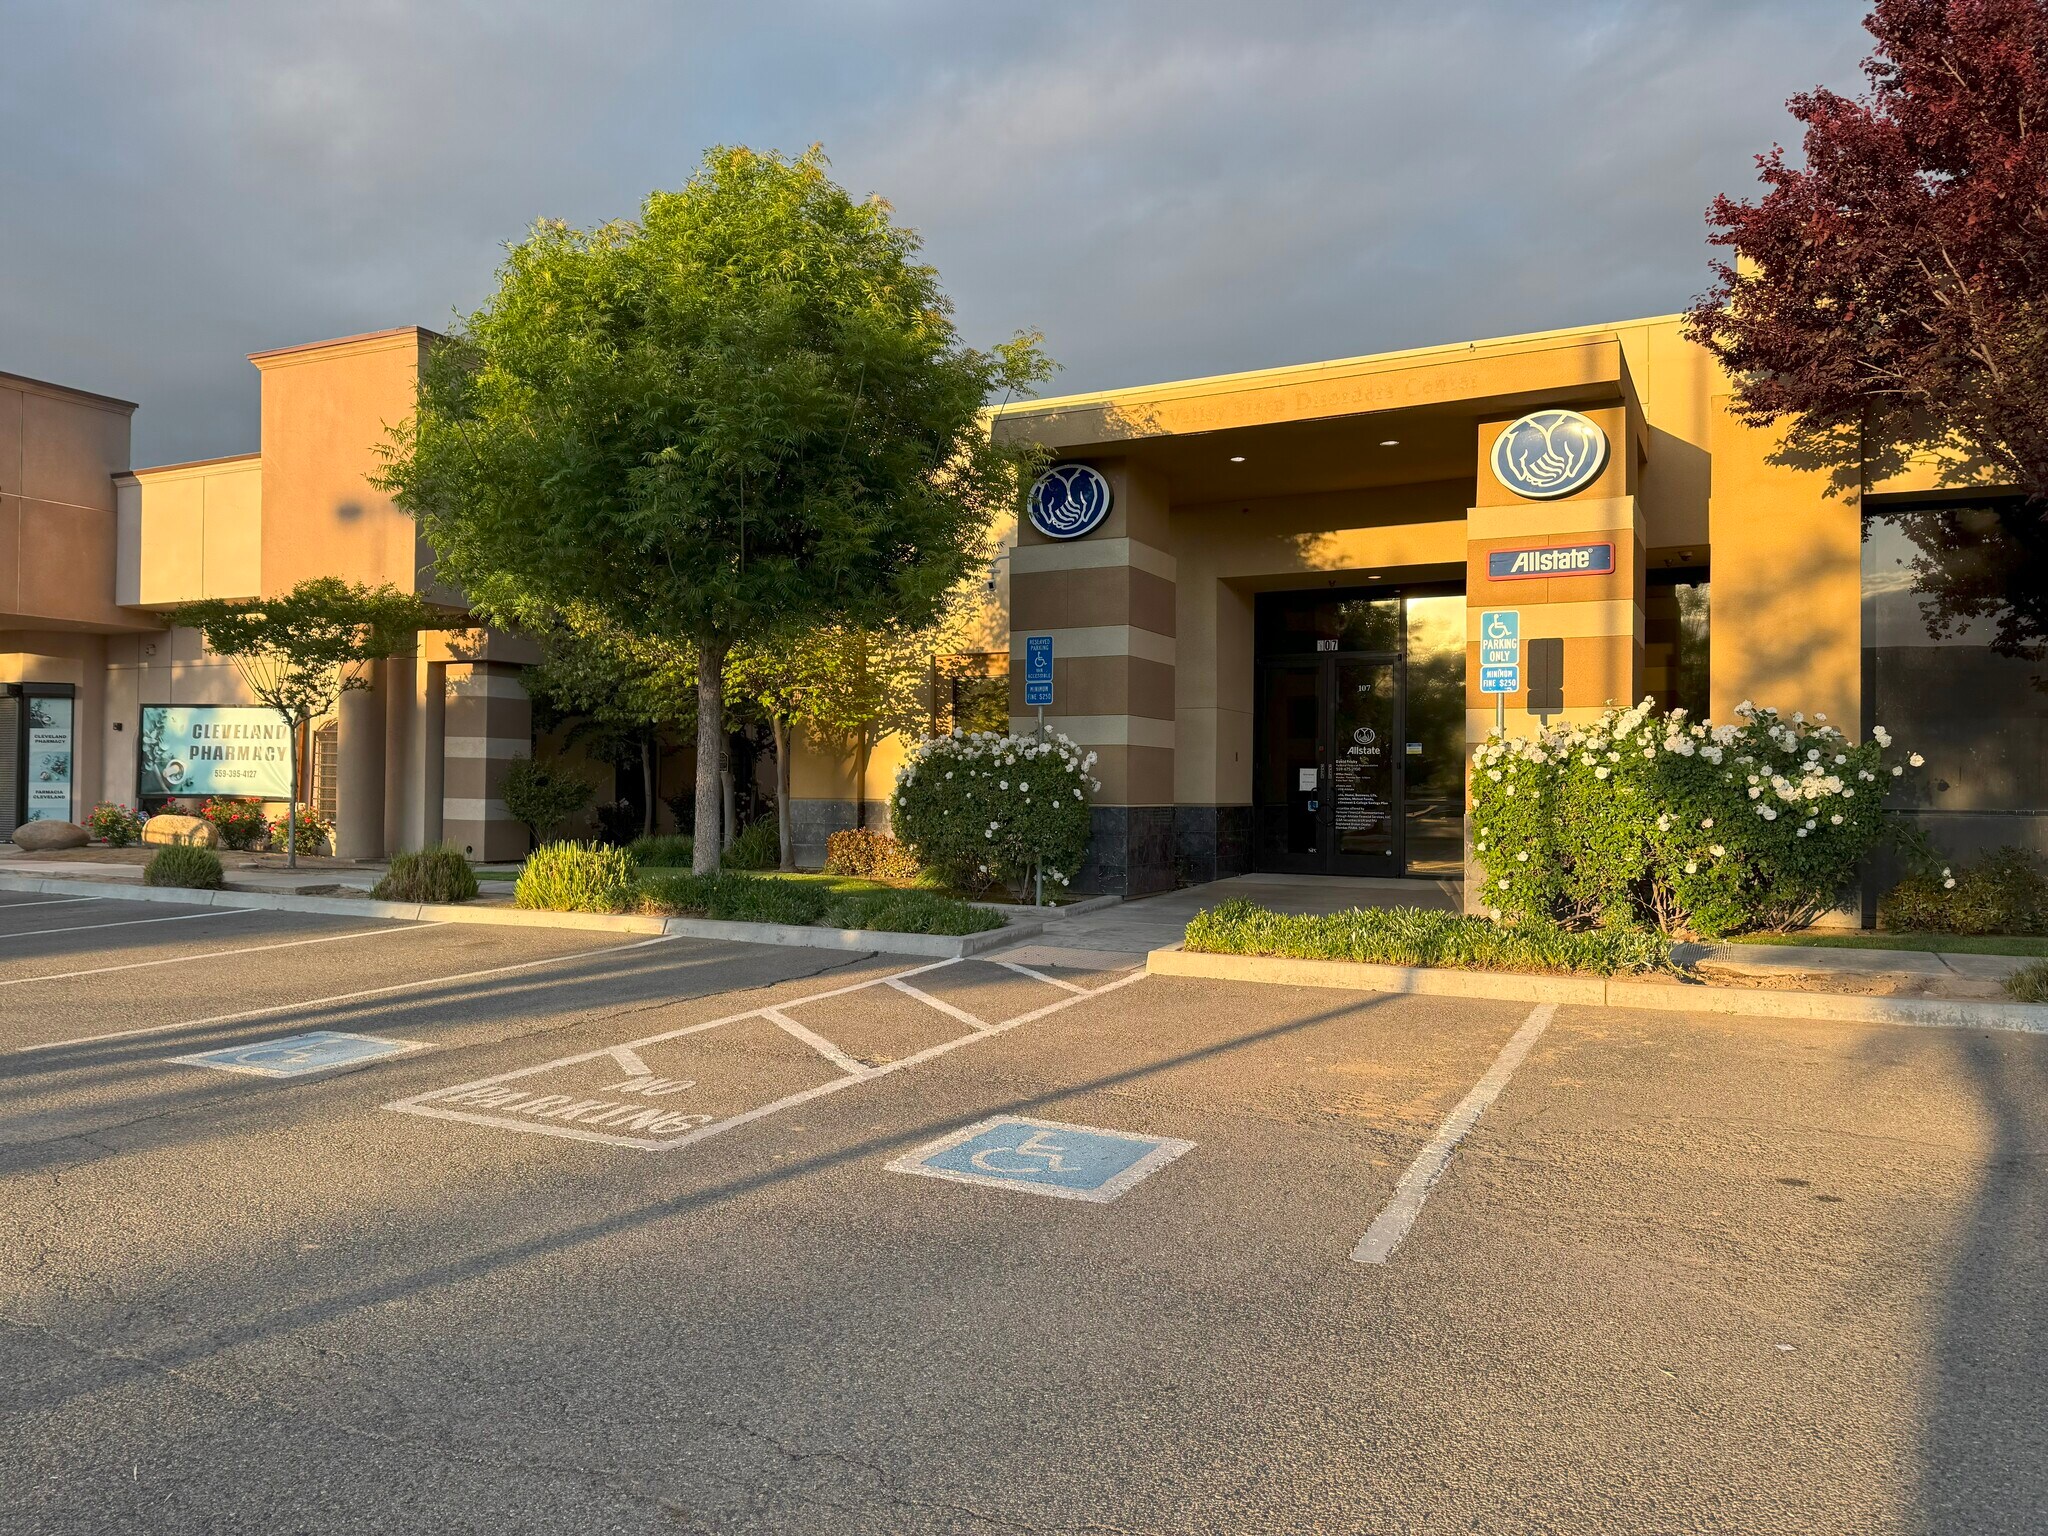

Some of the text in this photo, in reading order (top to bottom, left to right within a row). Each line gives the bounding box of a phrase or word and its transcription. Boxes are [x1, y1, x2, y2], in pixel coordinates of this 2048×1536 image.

[1482, 638, 1518, 650] PARKING
[1489, 651, 1511, 662] ONLY
[1486, 669, 1513, 678] MINIMUM
[1358, 684, 1371, 692] 107
[1483, 679, 1516, 687] FINE $250
[192, 723, 287, 739] CLEVELAND
[189, 745, 287, 761] PHARMACY
[1347, 746, 1381, 755] Allstate
[214, 769, 257, 778] 559-395-4127
[601, 1077, 697, 1095] NO
[440, 1086, 713, 1134] PARKING
